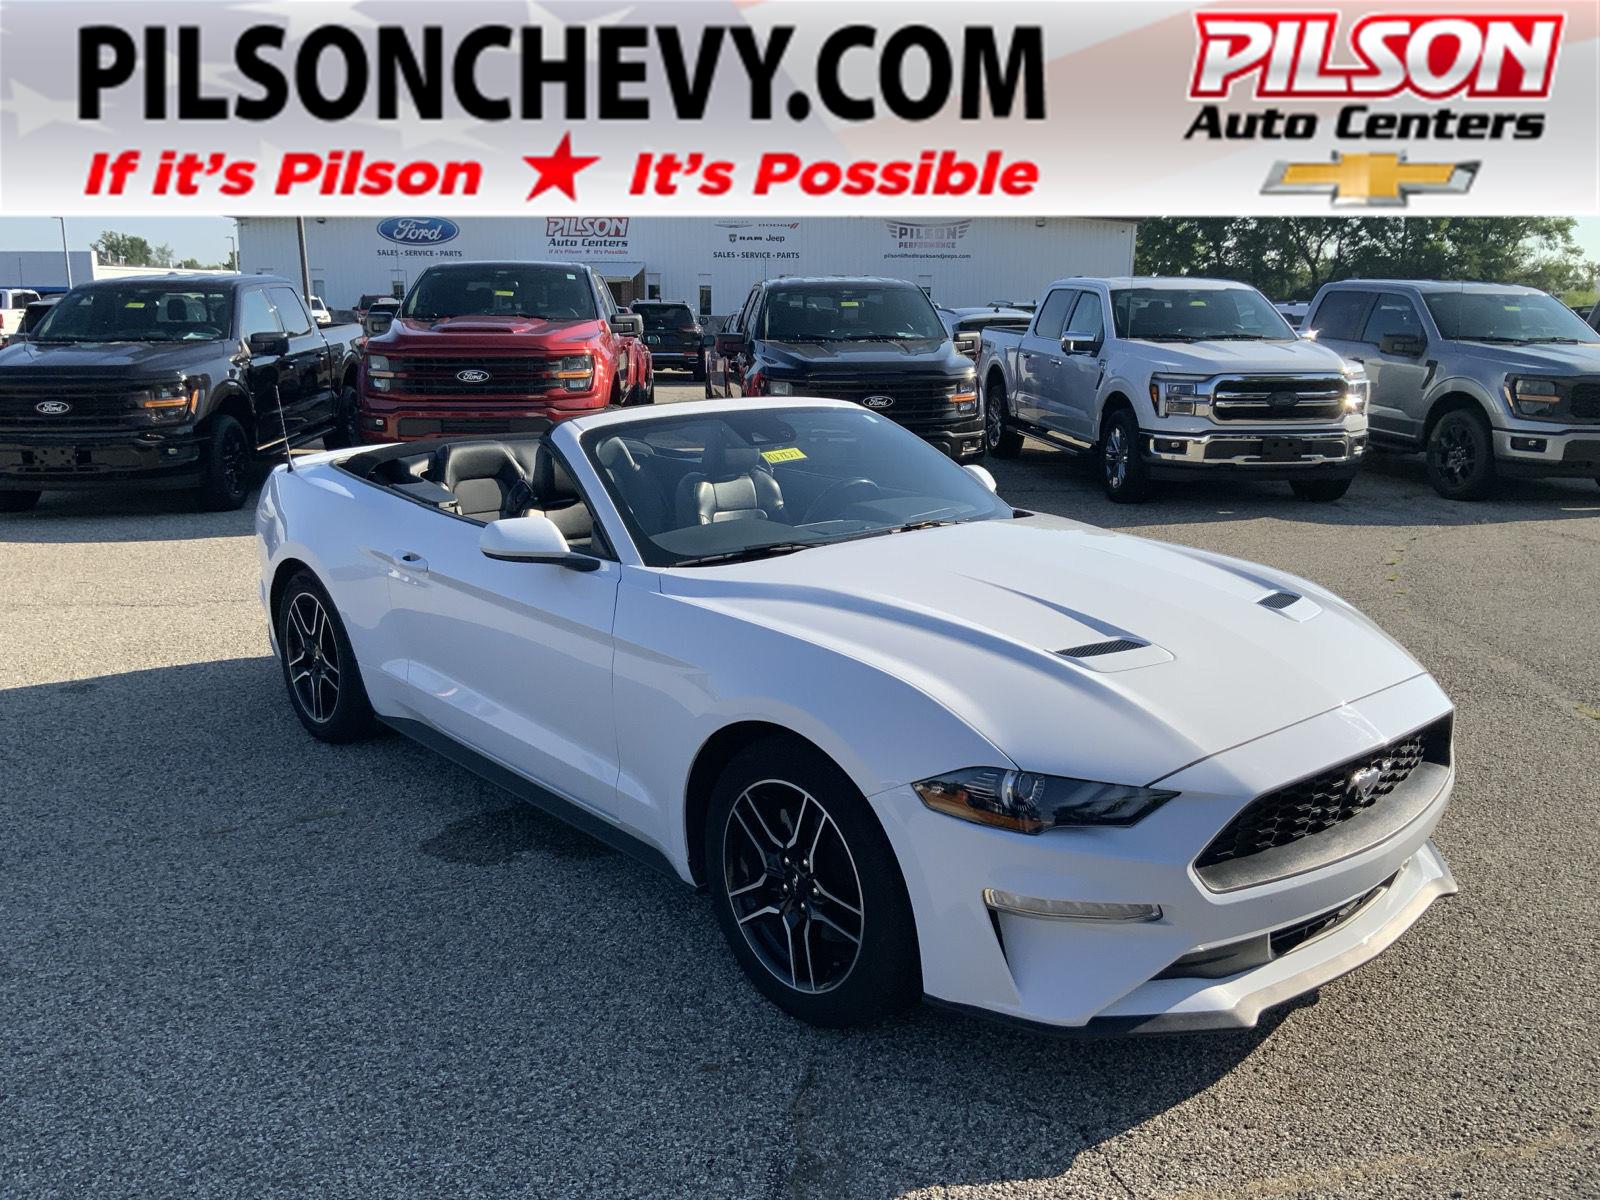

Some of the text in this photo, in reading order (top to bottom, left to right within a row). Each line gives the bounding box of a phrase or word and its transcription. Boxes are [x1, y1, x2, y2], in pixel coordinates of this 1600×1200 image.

[394, 218, 443, 240] Ford
[546, 216, 630, 237] PILSON
[898, 227, 957, 239] PILSON
[548, 238, 628, 247] Auto Centers
[765, 234, 786, 243] Jeep
[376, 249, 399, 257] SALES
[404, 249, 435, 257] SERVICE
[740, 251, 771, 259] SERVICE
[461, 370, 485, 381] Ford
[867, 397, 890, 406] Ford
[41, 401, 65, 413] Ford
